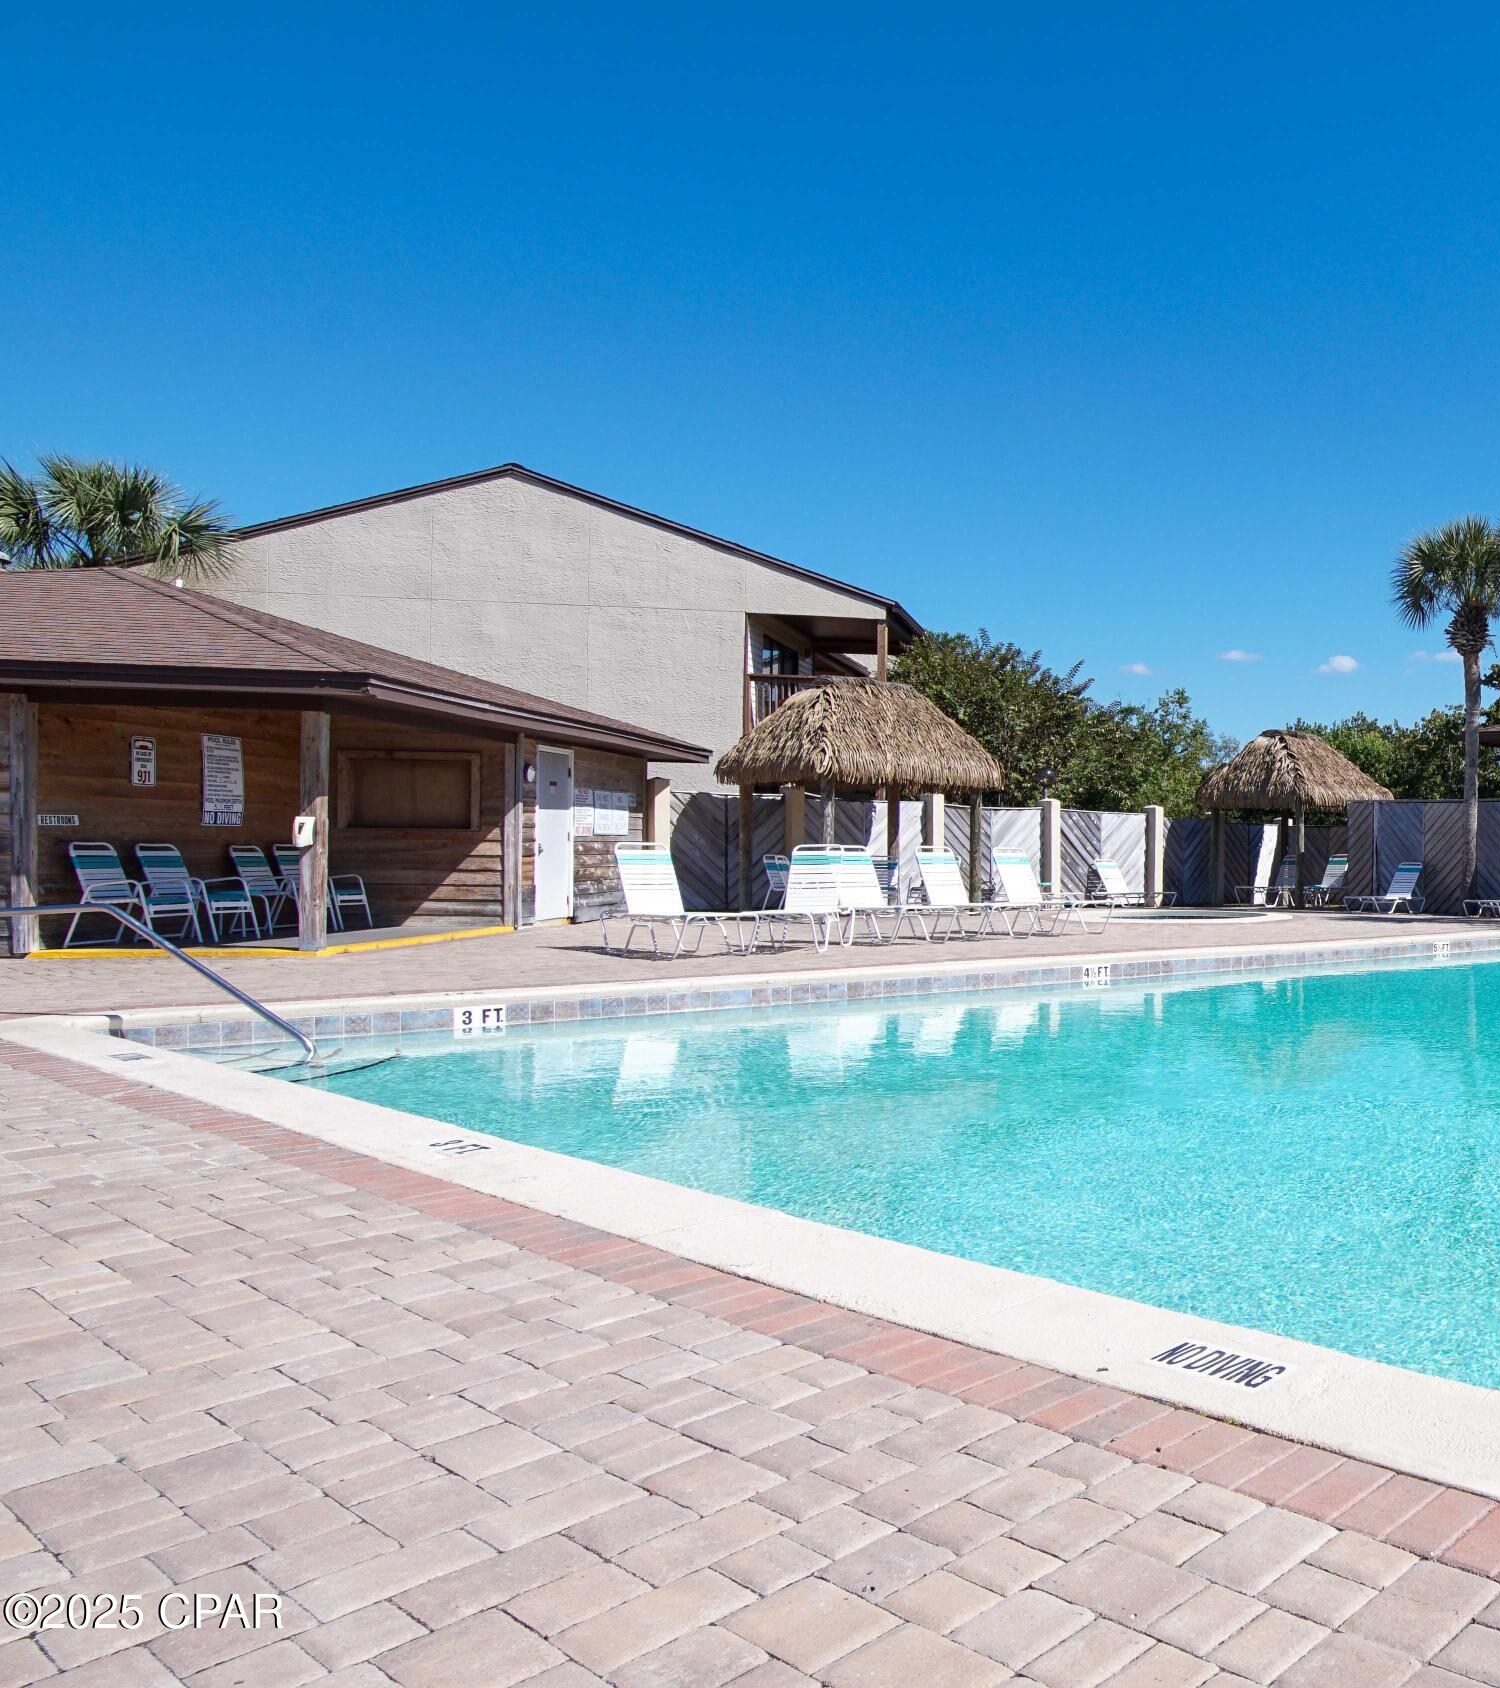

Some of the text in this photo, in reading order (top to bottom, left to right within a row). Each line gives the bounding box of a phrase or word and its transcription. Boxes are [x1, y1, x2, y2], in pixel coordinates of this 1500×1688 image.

[137, 769, 151, 783] 911
[40, 815, 76, 825] RESTROOMS
[204, 811, 242, 825] NO DIVING
[462, 1007, 504, 1025] 3 FT.
[428, 1139, 464, 1147] 3
[1150, 1342, 1286, 1388] NO DIVING
